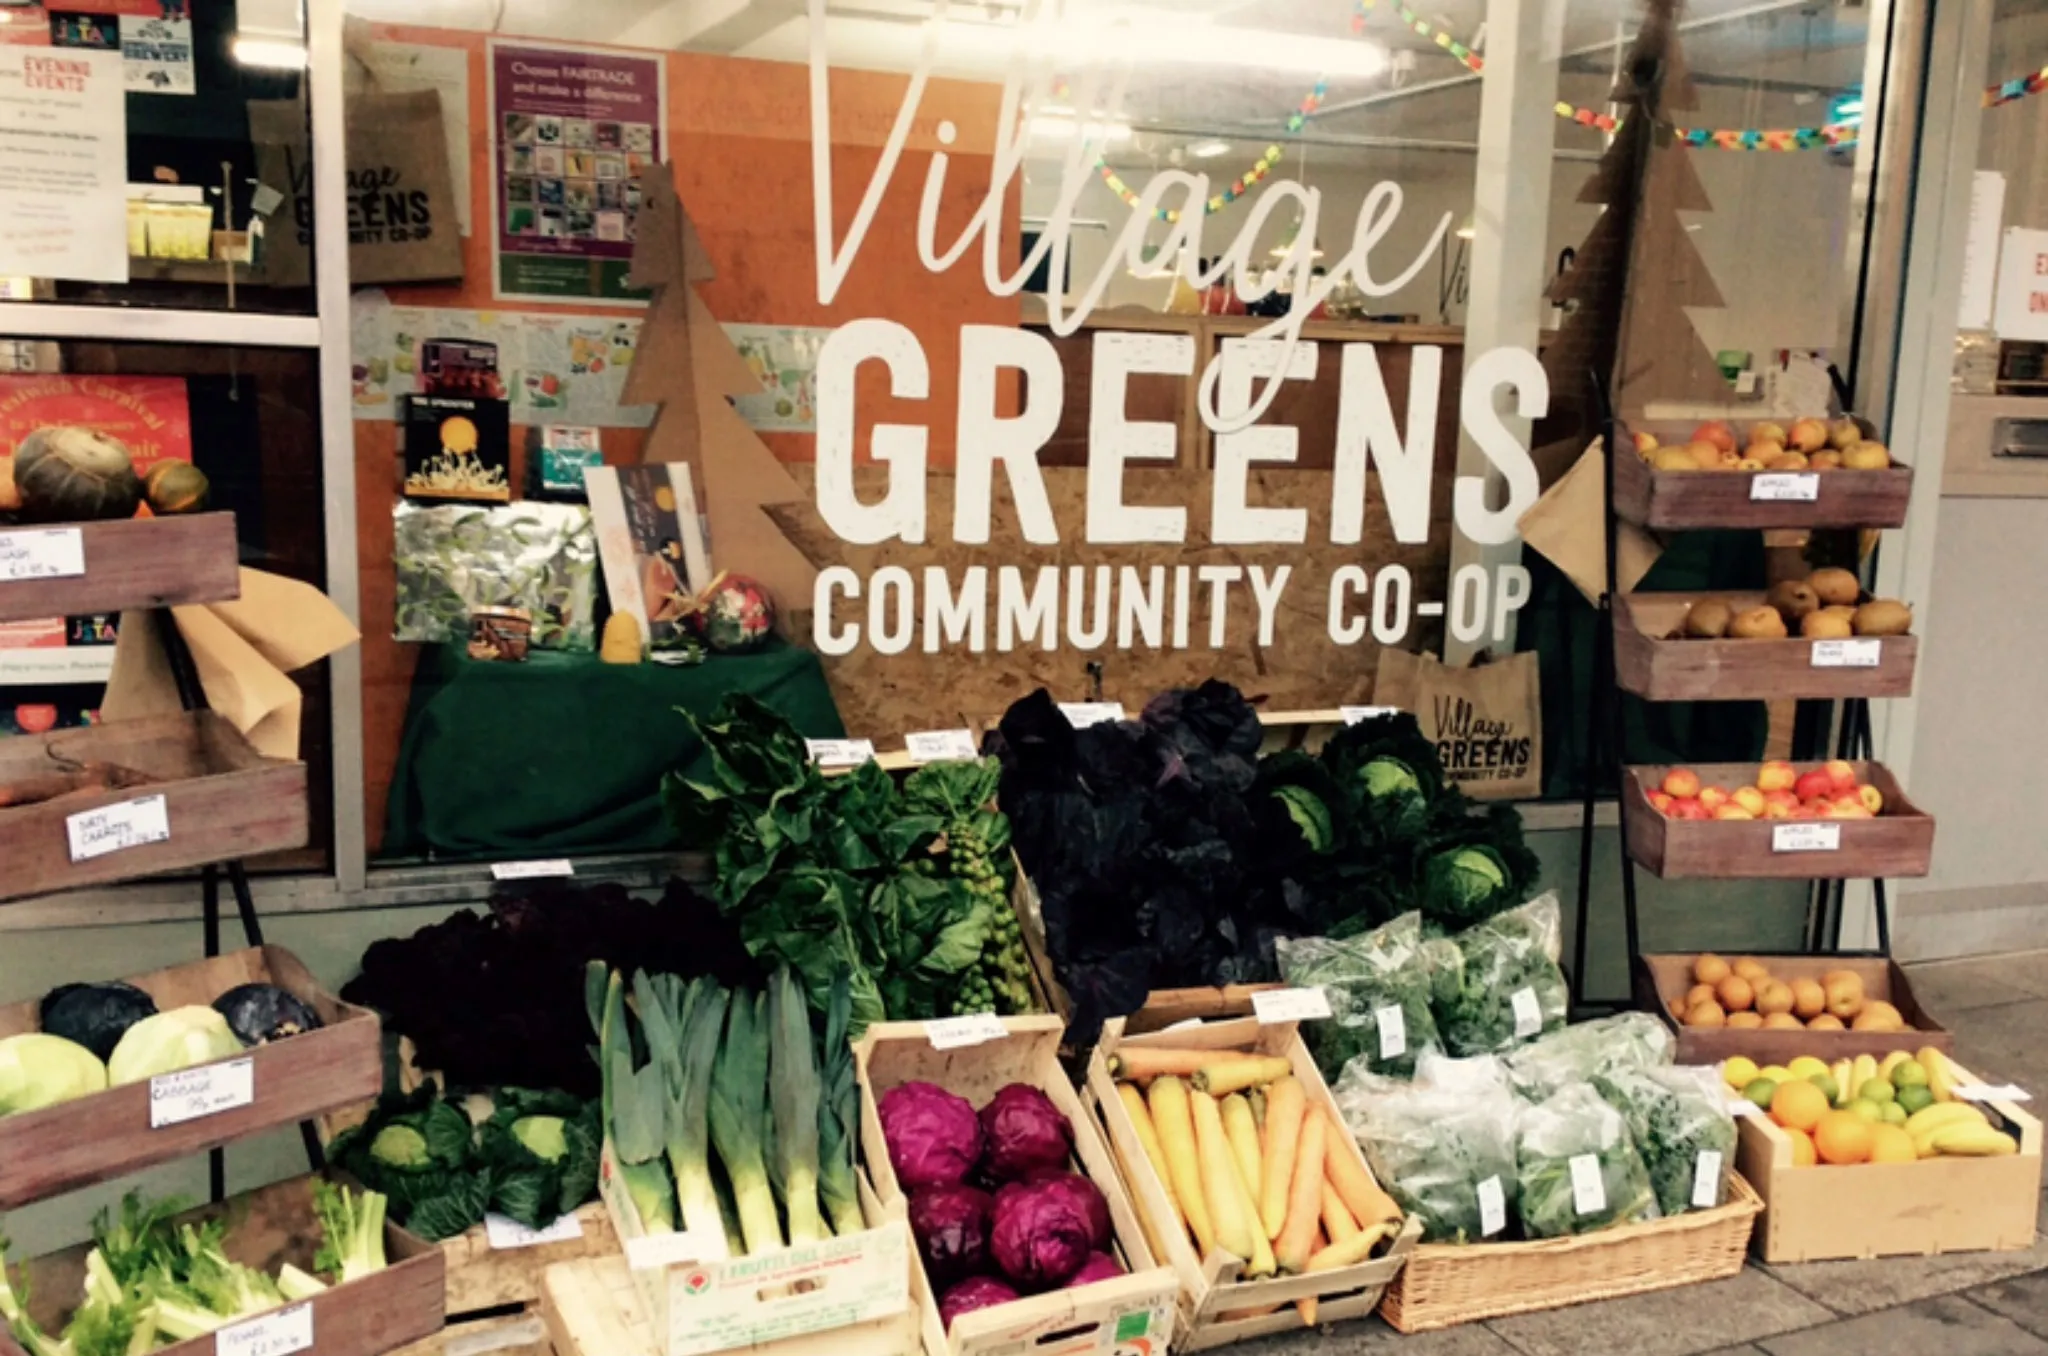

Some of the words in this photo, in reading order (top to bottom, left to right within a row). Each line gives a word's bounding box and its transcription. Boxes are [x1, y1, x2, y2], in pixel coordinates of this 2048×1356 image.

[24, 55, 91, 77] EVENING
[511, 62, 559, 78] Choose
[562, 66, 635, 85] FAIRTRADE
[25, 73, 85, 92] EVENTS
[513, 82, 535, 94] and
[538, 84, 570, 96] make
[584, 86, 642, 102] difference
[295, 190, 430, 228] GEENS
[809, 0, 1454, 434] Village
[815, 317, 1550, 545] GREENS
[813, 563, 1292, 656] COMMUNITY
[1327, 562, 1533, 647] CO-OP
[1436, 737, 1530, 769] GREENS
